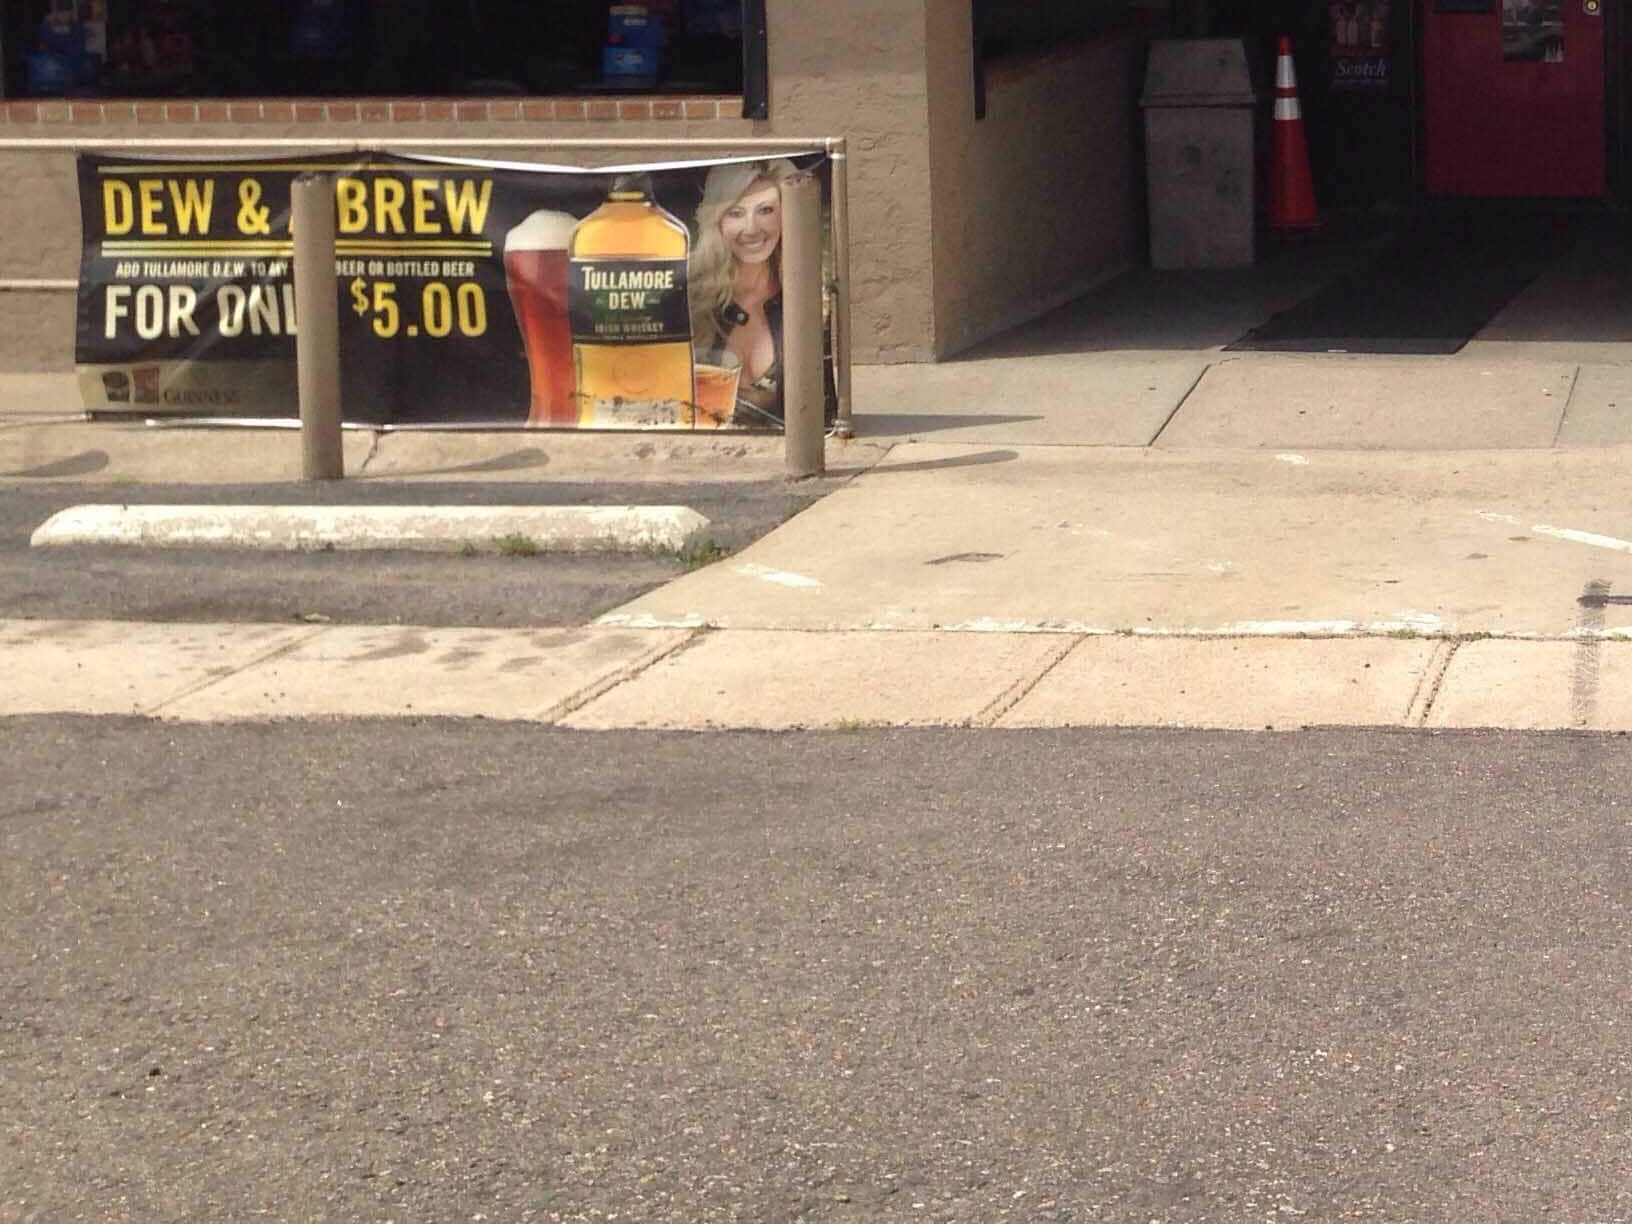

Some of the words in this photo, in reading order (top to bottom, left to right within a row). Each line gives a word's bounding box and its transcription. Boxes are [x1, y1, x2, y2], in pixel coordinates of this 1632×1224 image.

[103, 178, 215, 235] DEW
[236, 178, 271, 235] &
[336, 177, 493, 234] BREW
[115, 261, 140, 278] ADD
[143, 261, 210, 278] TULLAMORE
[251, 262, 267, 277] TO
[367, 261, 385, 277] OR
[386, 261, 441, 277] BOTTLED
[442, 261, 475, 277] BEER
[581, 266, 675, 291] TULLAMORE
[104, 283, 201, 340] FOR
[216, 283, 298, 338] ONL
[350, 276, 488, 339] $5.00
[608, 292, 646, 310] DEW
